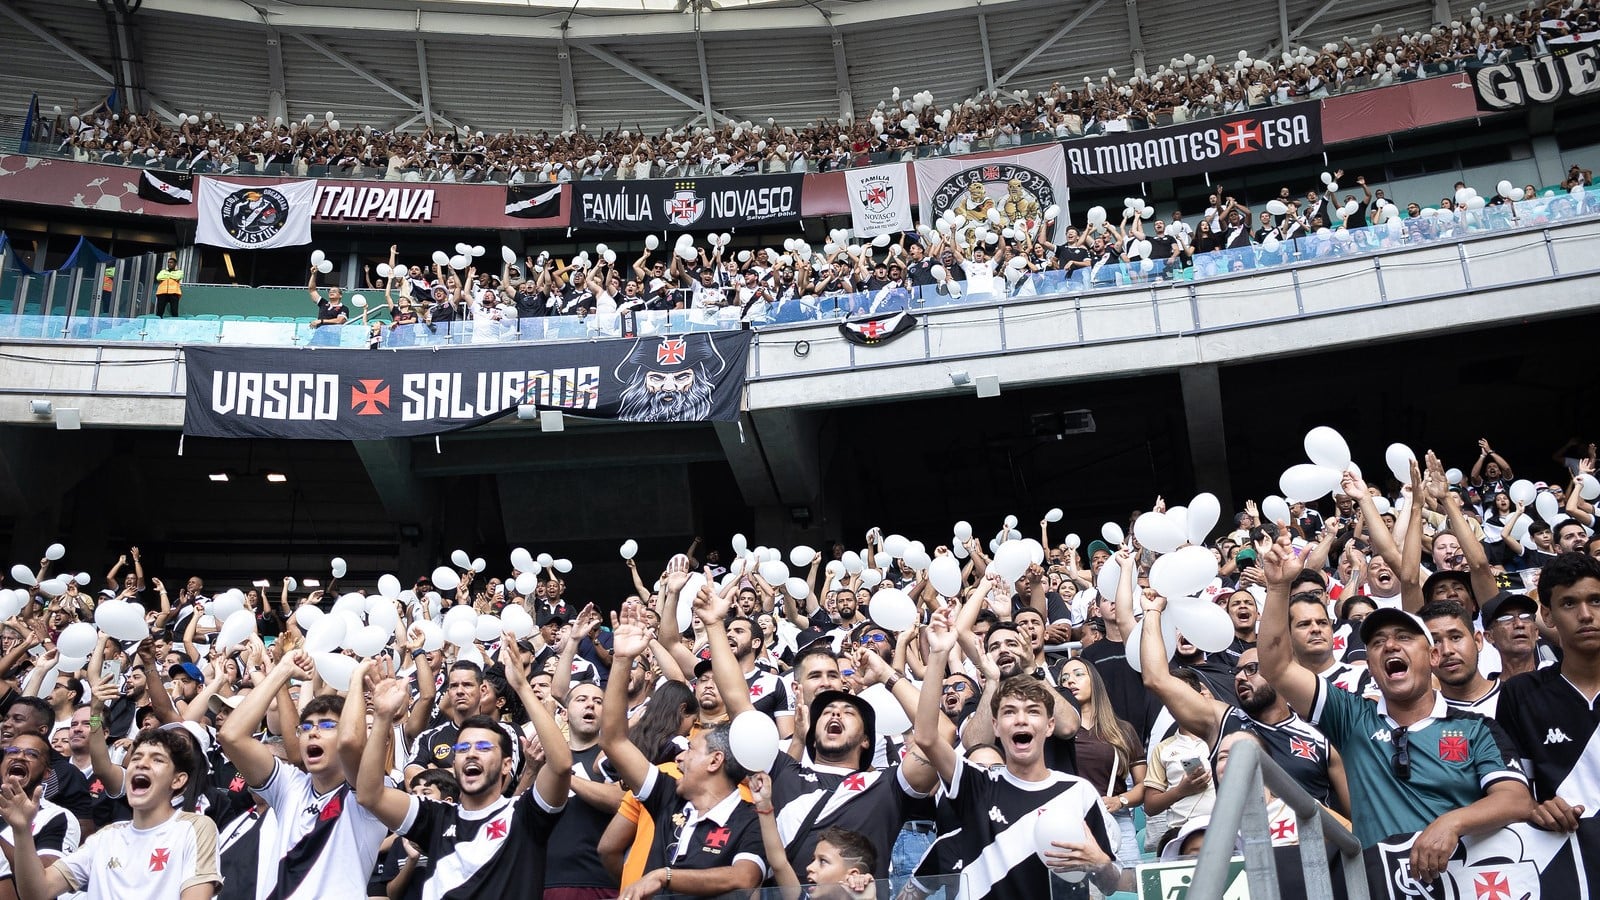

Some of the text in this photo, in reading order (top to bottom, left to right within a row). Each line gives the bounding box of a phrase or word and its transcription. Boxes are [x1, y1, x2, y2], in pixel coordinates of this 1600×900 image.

[1067, 114, 1311, 175] ALMIRANTES FSA
[311, 185, 435, 221] ITAIPAVA
[582, 185, 793, 222] FAMÍLIA NOVASCO
[864, 212, 896, 220] NOVASCO
[213, 365, 600, 422] VASCO SALVADOR
